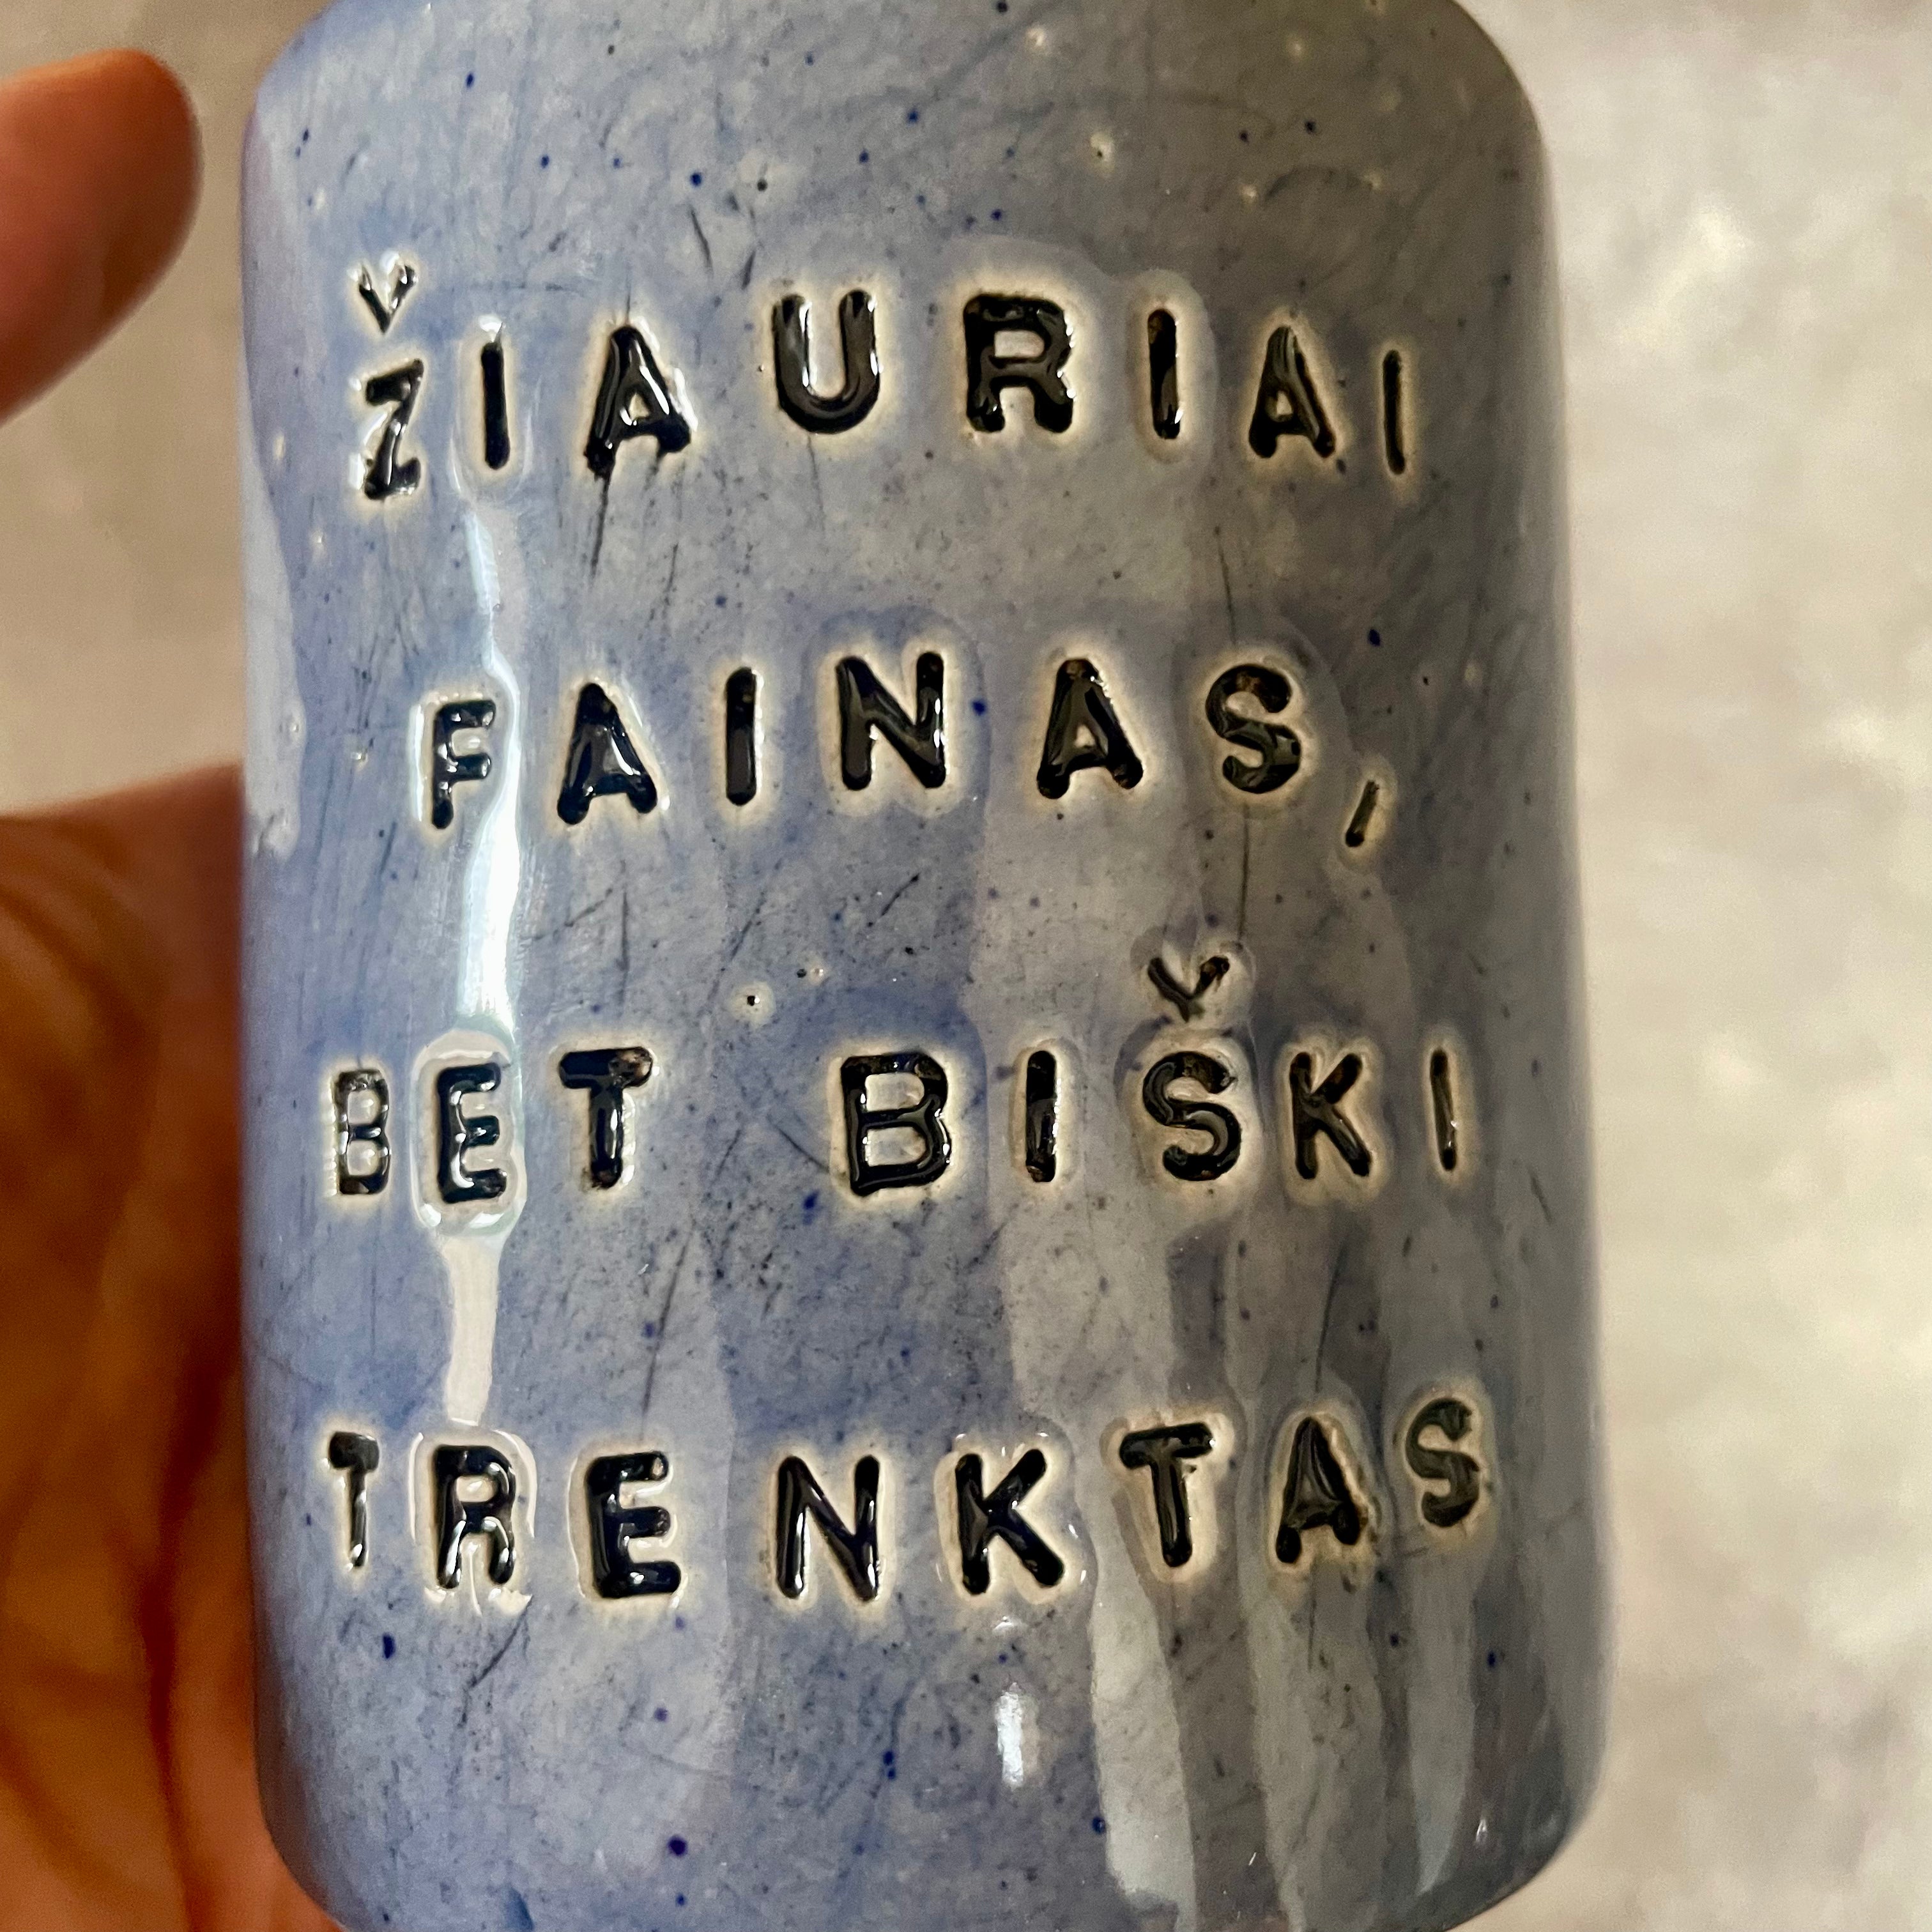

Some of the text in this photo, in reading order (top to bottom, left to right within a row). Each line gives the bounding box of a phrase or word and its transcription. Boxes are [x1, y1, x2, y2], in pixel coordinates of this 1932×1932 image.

[356, 263, 1407, 502] ŽIAURIAI
[430, 650, 1382, 849] FAINAS,
[330, 954, 1458, 1203] BET BIŠKI
[327, 1395, 1483, 1602] TRENKTAS
